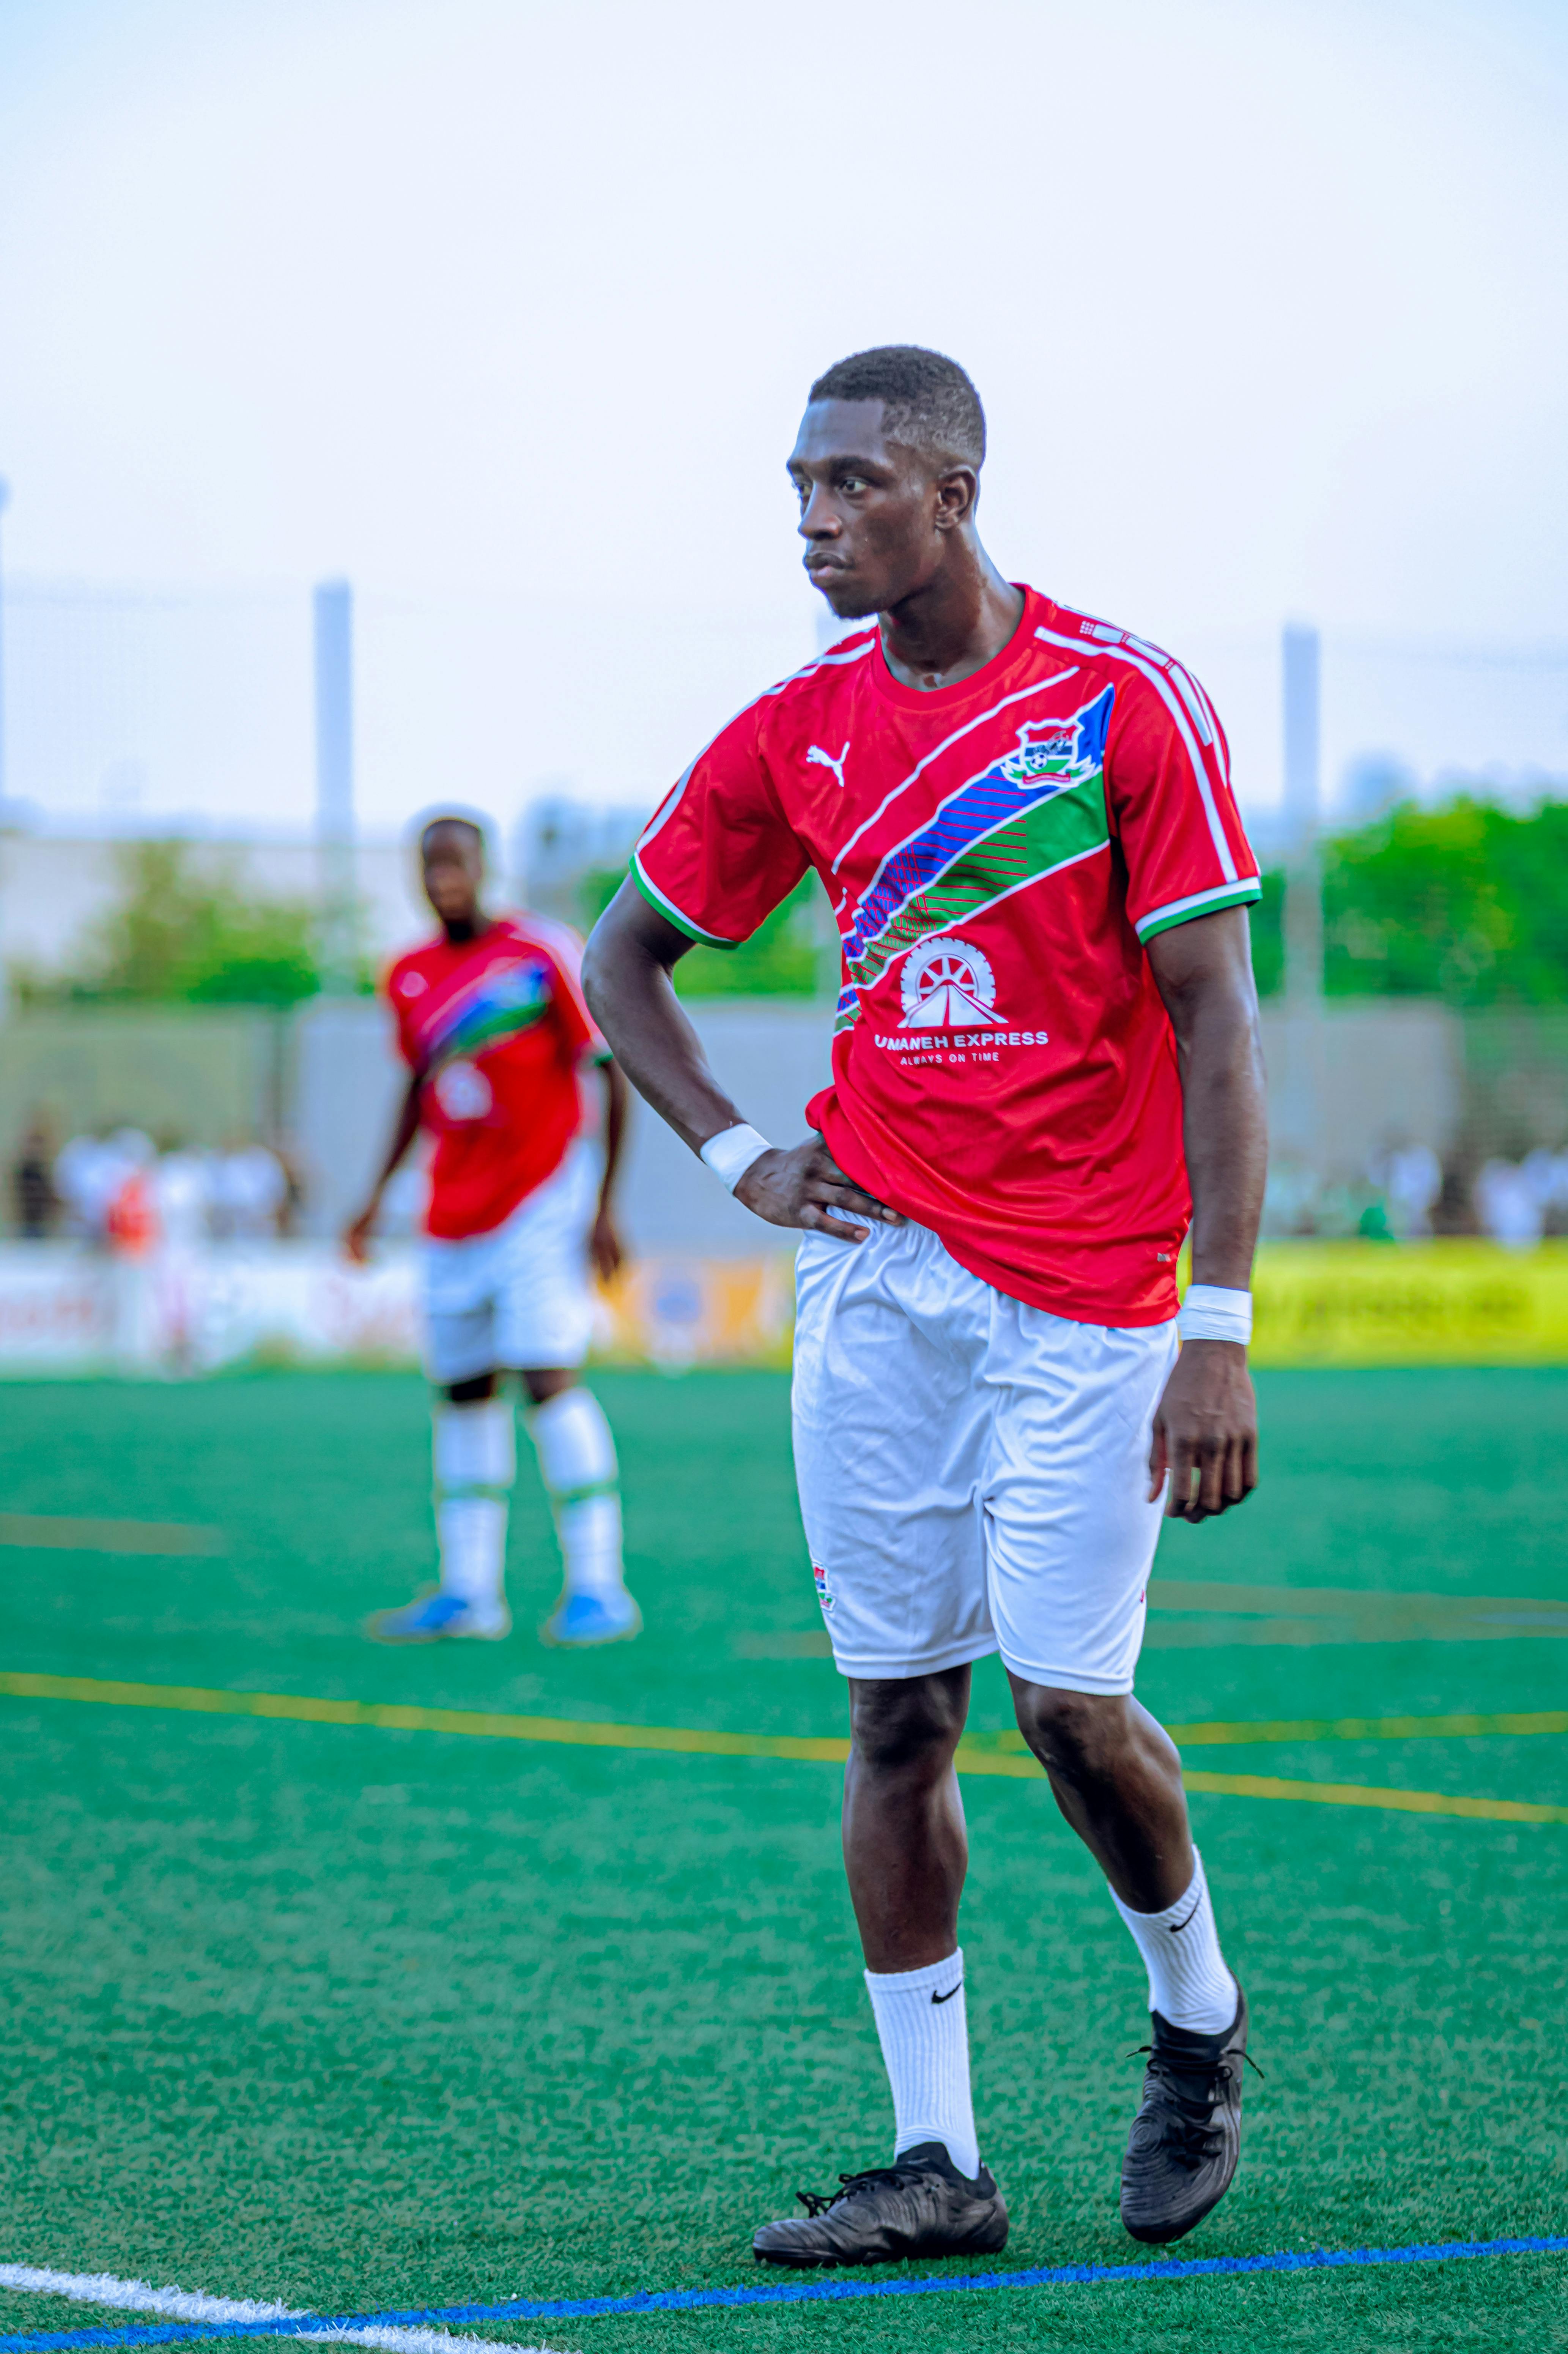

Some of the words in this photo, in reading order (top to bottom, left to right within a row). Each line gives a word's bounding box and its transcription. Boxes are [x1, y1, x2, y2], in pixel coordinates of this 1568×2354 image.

[953, 1031, 1048, 1048] EXPRESS
[900, 1054, 943, 1065] ALWAYS
[949, 1054, 965, 1063] ON
[971, 1052, 999, 1062] TIME
